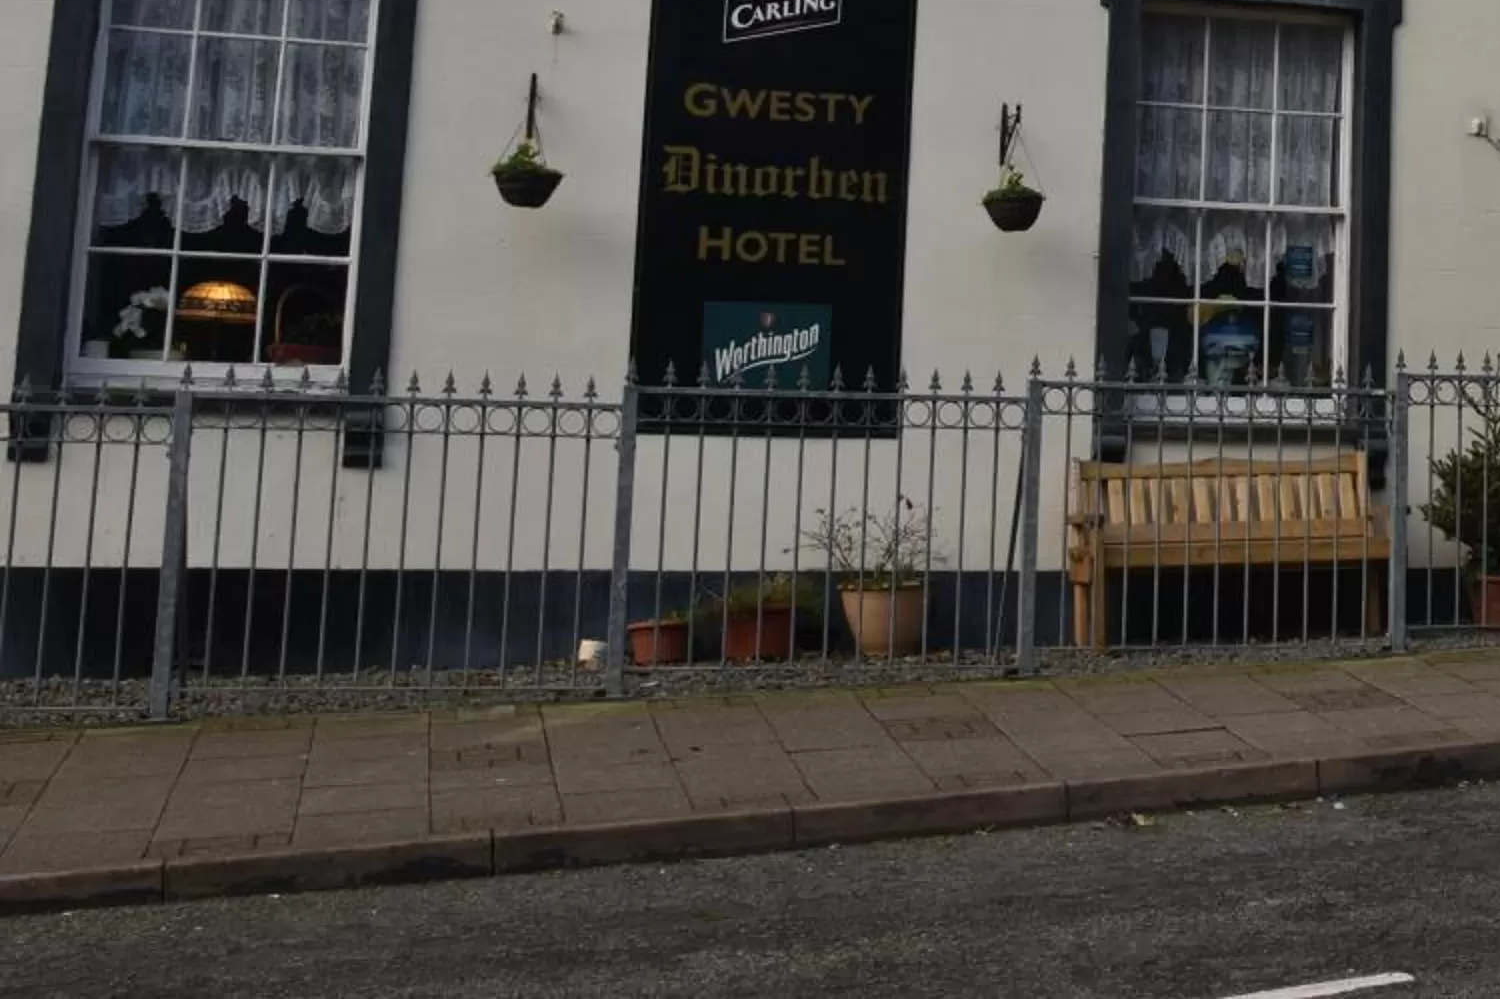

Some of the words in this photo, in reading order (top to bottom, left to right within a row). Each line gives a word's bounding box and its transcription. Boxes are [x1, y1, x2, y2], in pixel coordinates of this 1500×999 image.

[684, 81, 875, 125] GWESTY
[662, 145, 889, 203] Dinorben
[697, 226, 847, 267] HOTEL
[714, 322, 820, 380] Worthington
